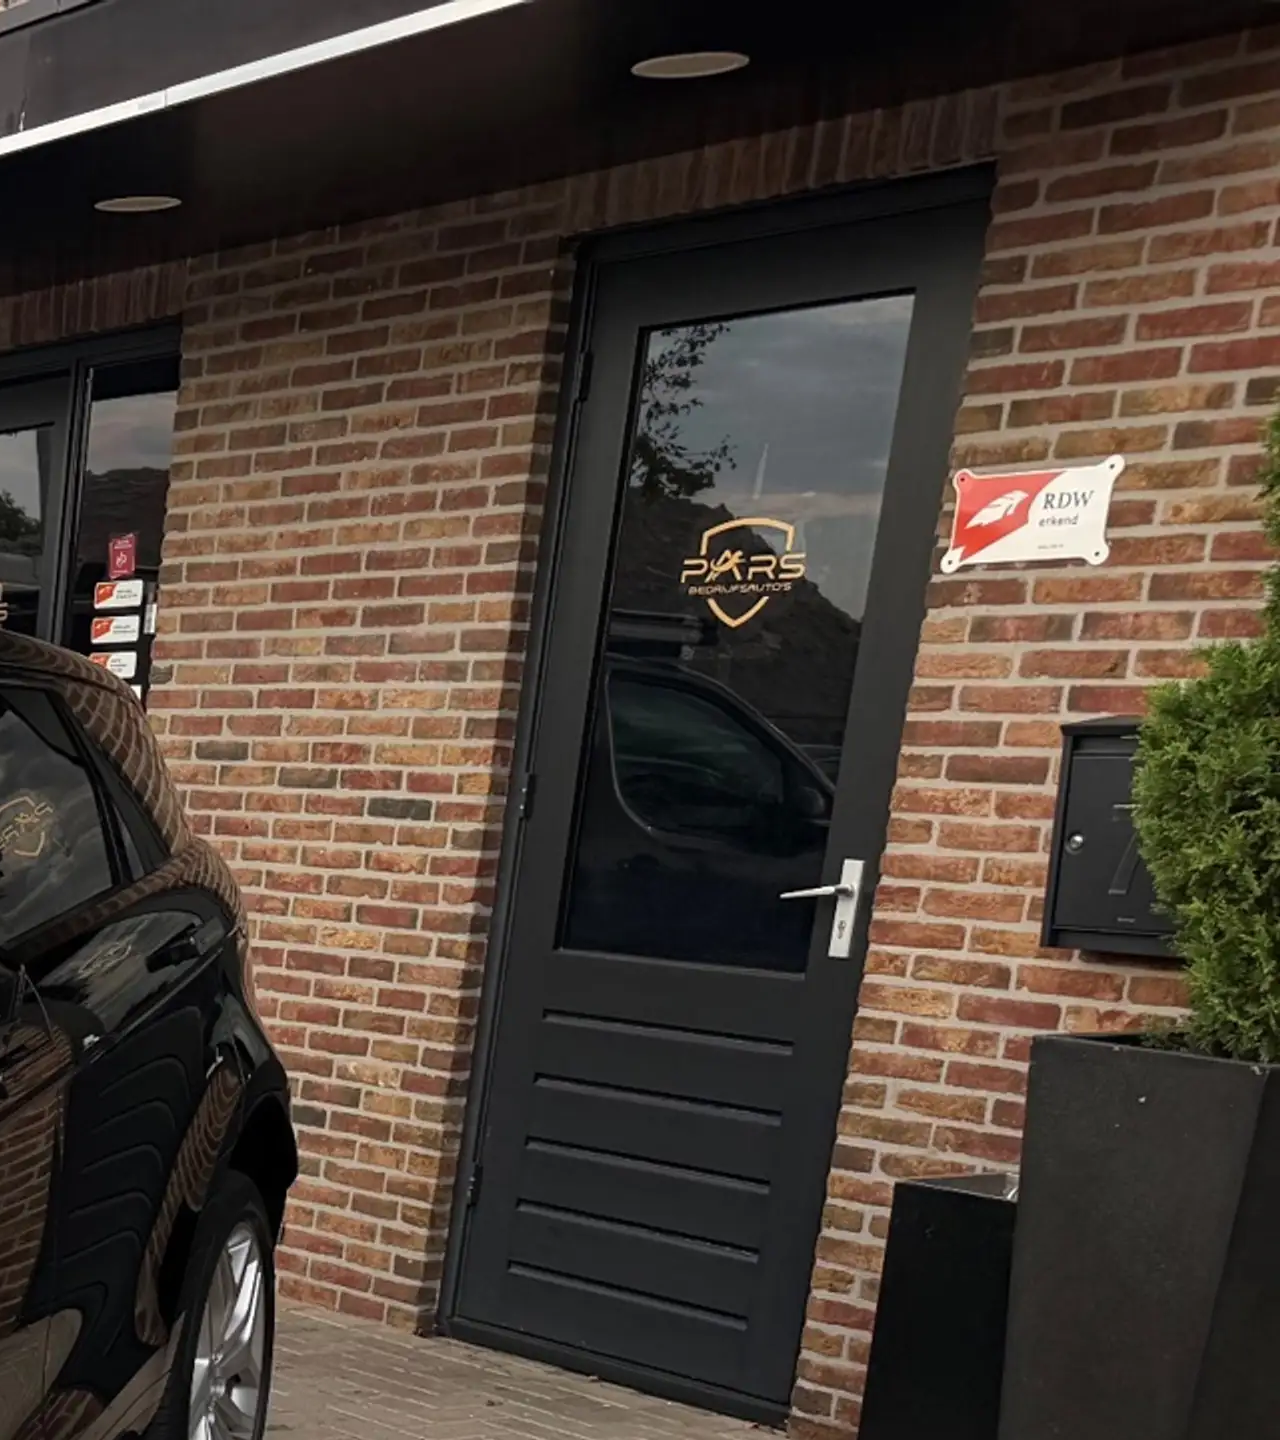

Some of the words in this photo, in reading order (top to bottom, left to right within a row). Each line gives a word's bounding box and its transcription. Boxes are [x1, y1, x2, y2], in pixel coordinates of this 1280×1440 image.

[1042, 489, 1095, 510] RDW
[1038, 512, 1080, 527] erkend
[680, 549, 807, 584] PARS
